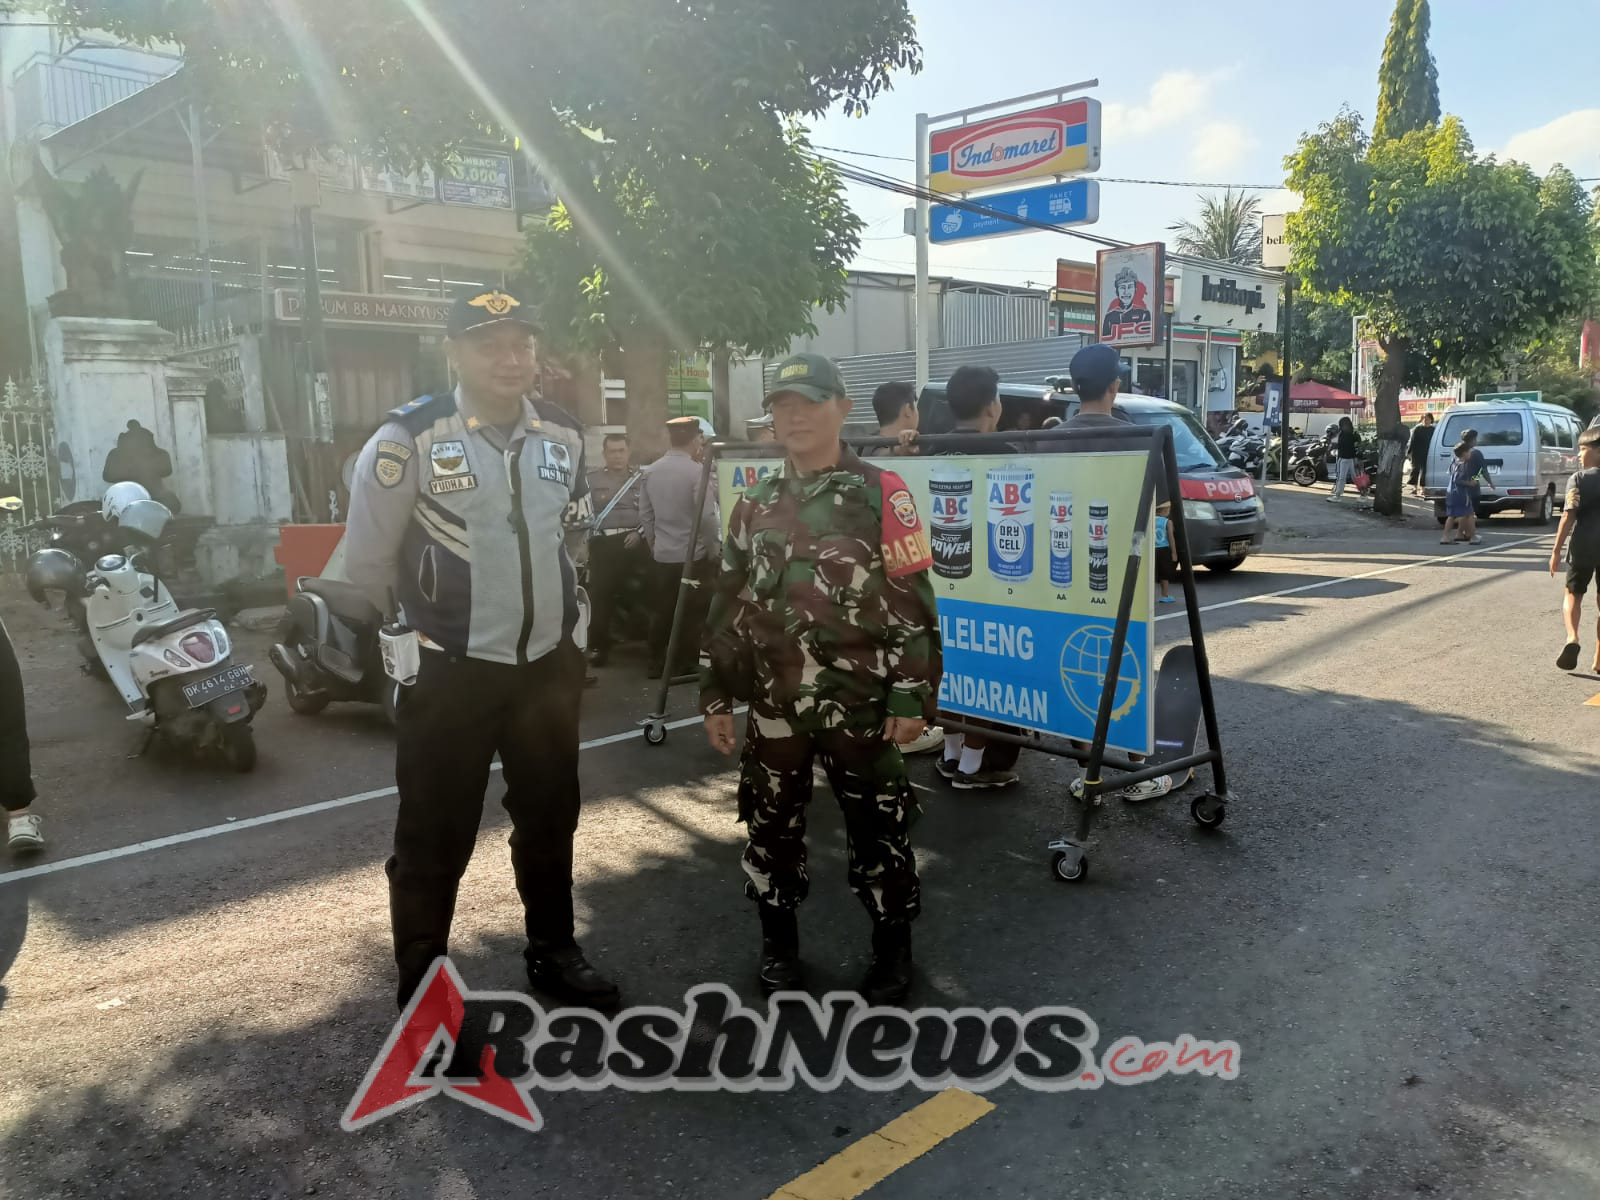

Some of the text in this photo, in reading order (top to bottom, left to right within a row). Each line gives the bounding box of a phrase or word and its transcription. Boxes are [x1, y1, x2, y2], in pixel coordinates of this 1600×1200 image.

[957, 129, 1057, 169] Indomaret
[973, 218, 1000, 229] payment
[353, 302, 369, 316] 88
[1100, 321, 1152, 342] JFC
[989, 482, 1032, 505] ABC
[933, 497, 968, 516] ABC
[1050, 505, 1073, 517] ABC
[999, 525, 1020, 537] DRY
[1053, 530, 1069, 539] DRY
[931, 539, 971, 560] POWER
[999, 538, 1021, 551] CELL
[1053, 541, 1069, 549] CELL
[1056, 593, 1067, 601] AA
[1091, 597, 1107, 605] AAA
[185, 666, 248, 697] DK 4614 GBH
